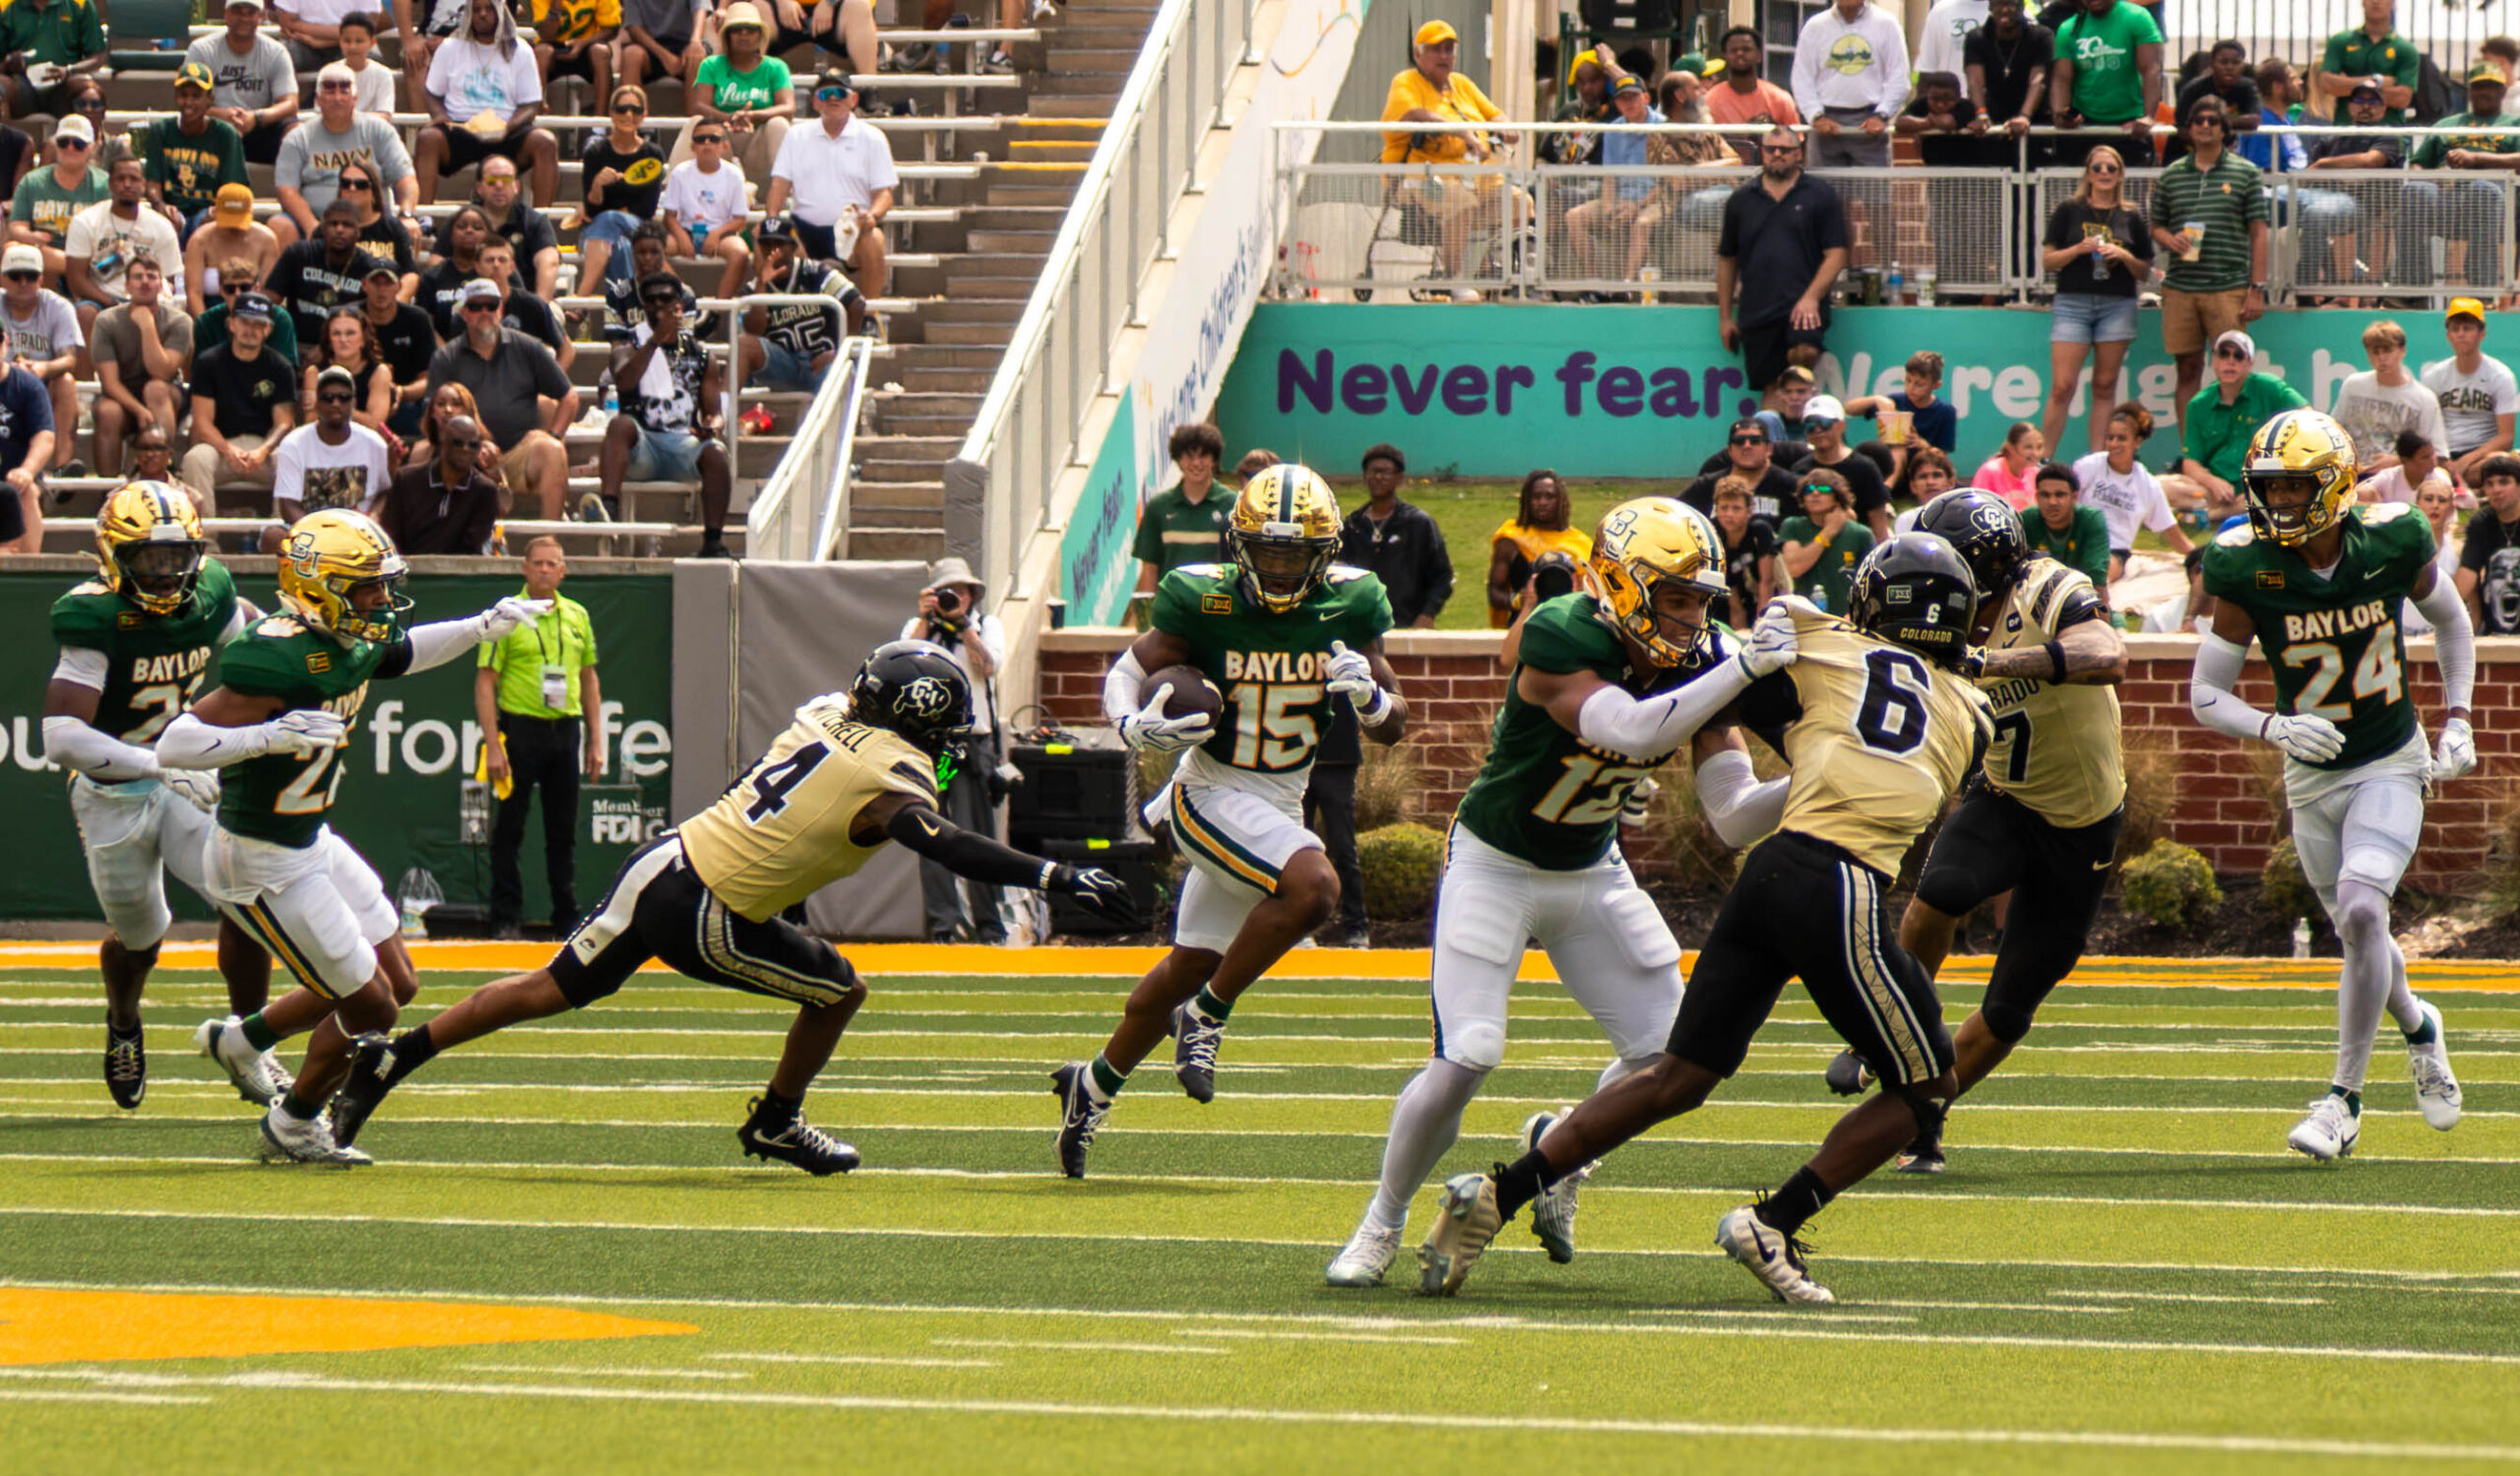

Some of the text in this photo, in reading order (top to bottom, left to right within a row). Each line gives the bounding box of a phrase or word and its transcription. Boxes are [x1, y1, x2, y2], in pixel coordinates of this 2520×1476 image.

[220, 66, 245, 76] JUST
[312, 147, 372, 168] NAVY
[32, 201, 94, 219] BAYLO
[302, 267, 362, 292] COLORADO
[774, 304, 820, 325] LORADO
[1277, 348, 1757, 418] Never fear.
[1926, 603, 1941, 623] 6
[2284, 599, 2387, 642] BAYLOR
[1900, 627, 1952, 643] COLORADO
[131, 645, 211, 682] BAYLOR
[1225, 650, 1330, 681] BAYLOR
[2280, 618, 2404, 722] 24
[1856, 648, 1933, 758] 6
[369, 700, 484, 775] for
[1228, 682, 1325, 768] 15
[1992, 707, 2033, 783] 7
[742, 737, 839, 826] 4
[1530, 752, 1656, 826] 12
[593, 799, 665, 817] Member
[593, 814, 665, 844] FDIC
